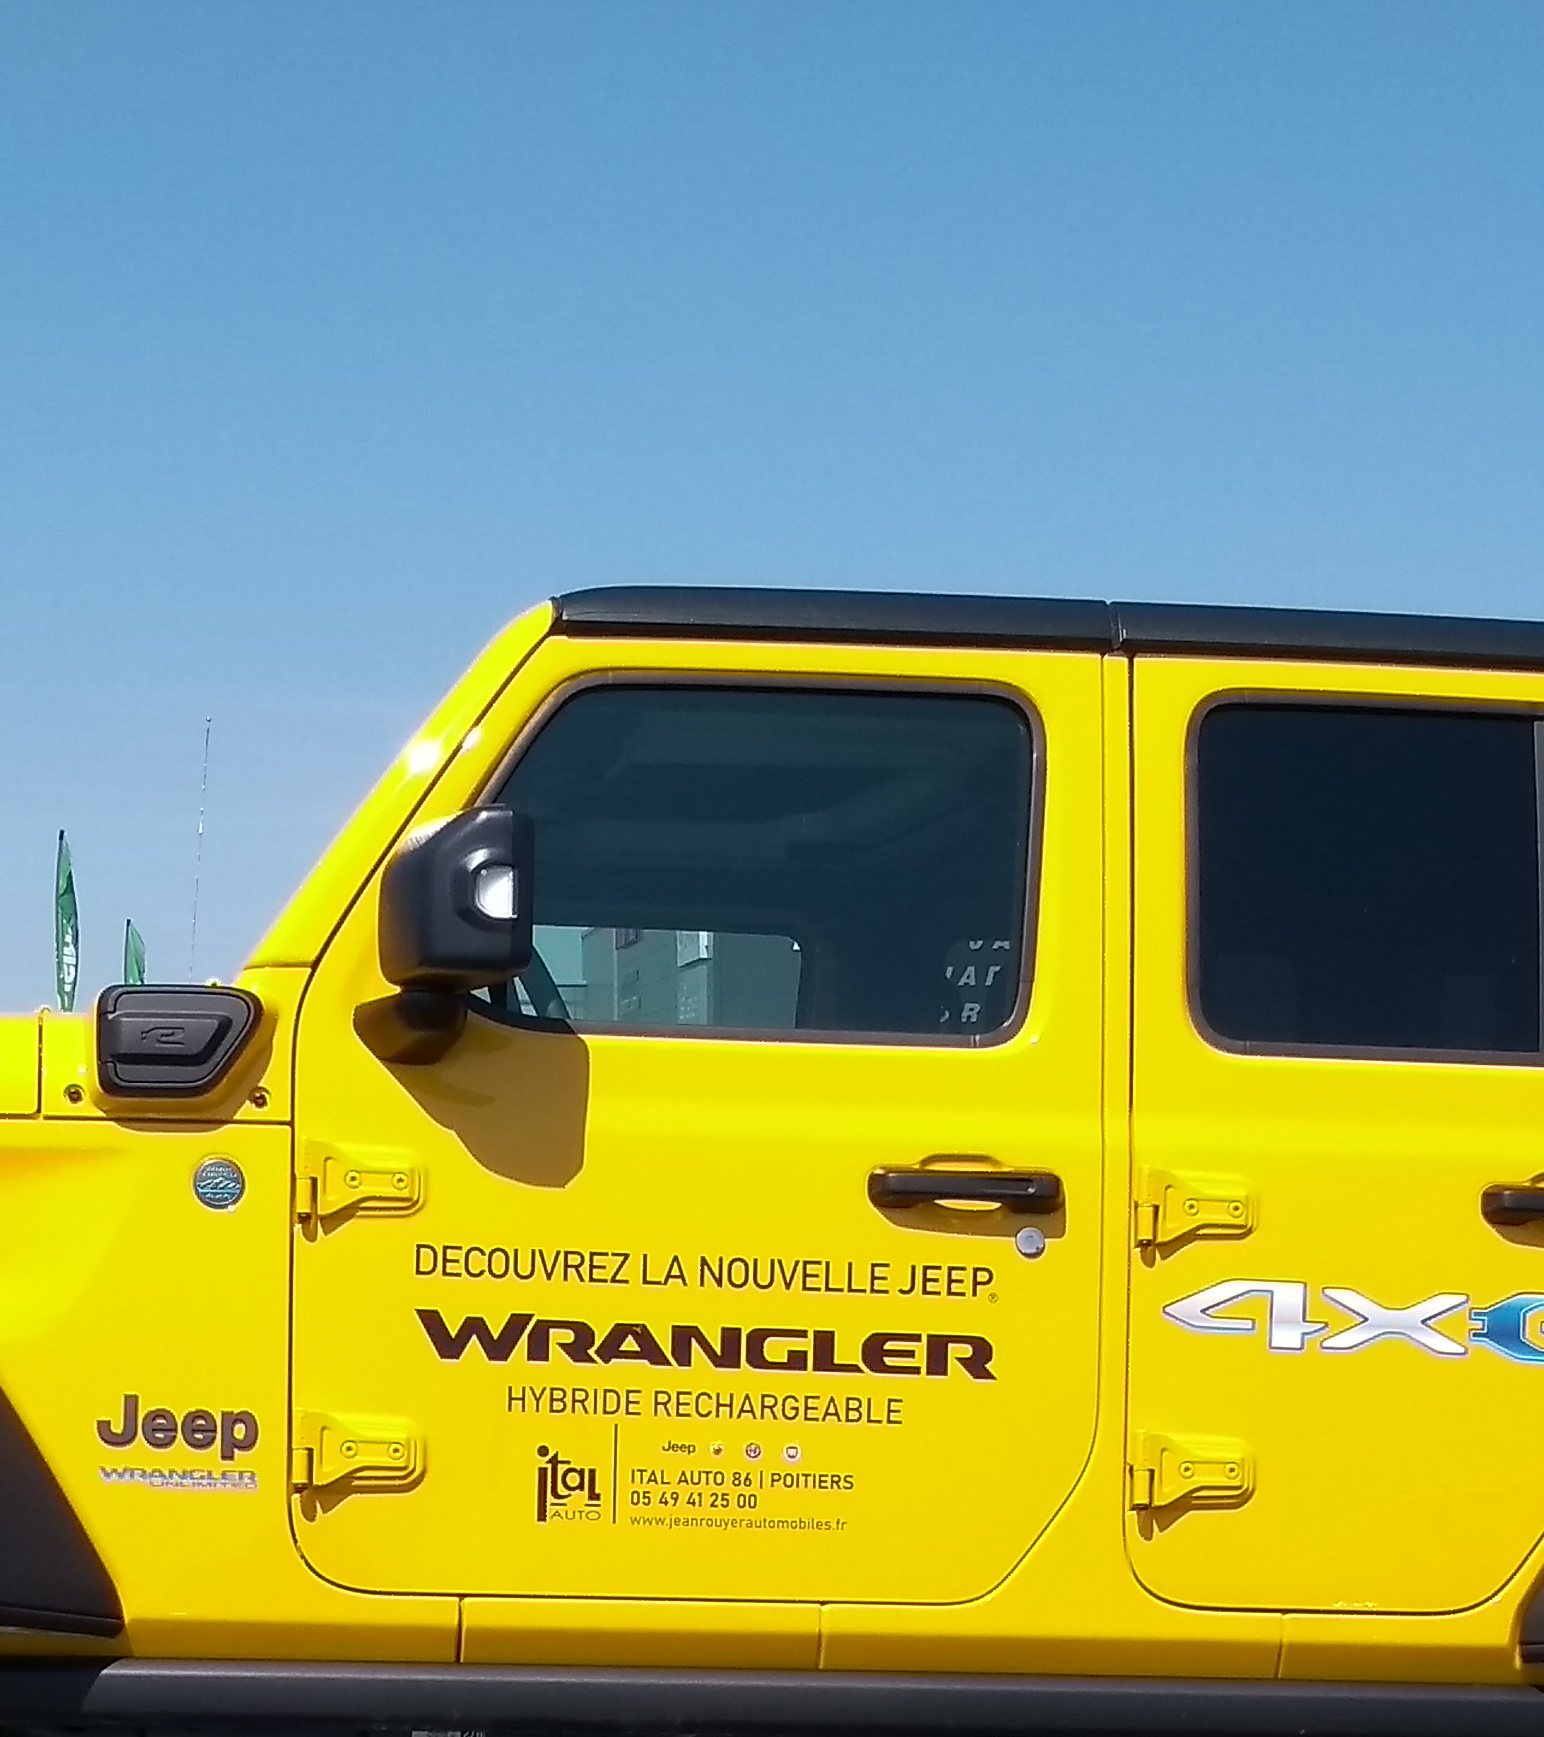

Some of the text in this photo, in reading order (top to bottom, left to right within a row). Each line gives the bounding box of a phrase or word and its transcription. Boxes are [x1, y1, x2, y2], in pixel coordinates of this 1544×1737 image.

[414, 1243, 630, 1286] DECOUVREZ
[642, 1253, 688, 1288] LA
[699, 1256, 890, 1295] NOUVELLE
[414, 1308, 997, 1381] WRANGLER
[507, 1386, 904, 1426] HYBRIDE RECHARGEABLE
[96, 1392, 259, 1461] Jeep
[662, 1440, 696, 1455] Jeep
[99, 1465, 257, 1482] WRANGLER
[630, 1469, 855, 1490] ITAL AUTO 86 POITIERS
[630, 1492, 758, 1509] 05 49 41 25 00
[550, 1509, 602, 1521] AUTO
[629, 1514, 847, 1532] www.jeanrouyerautomobiles.fr
